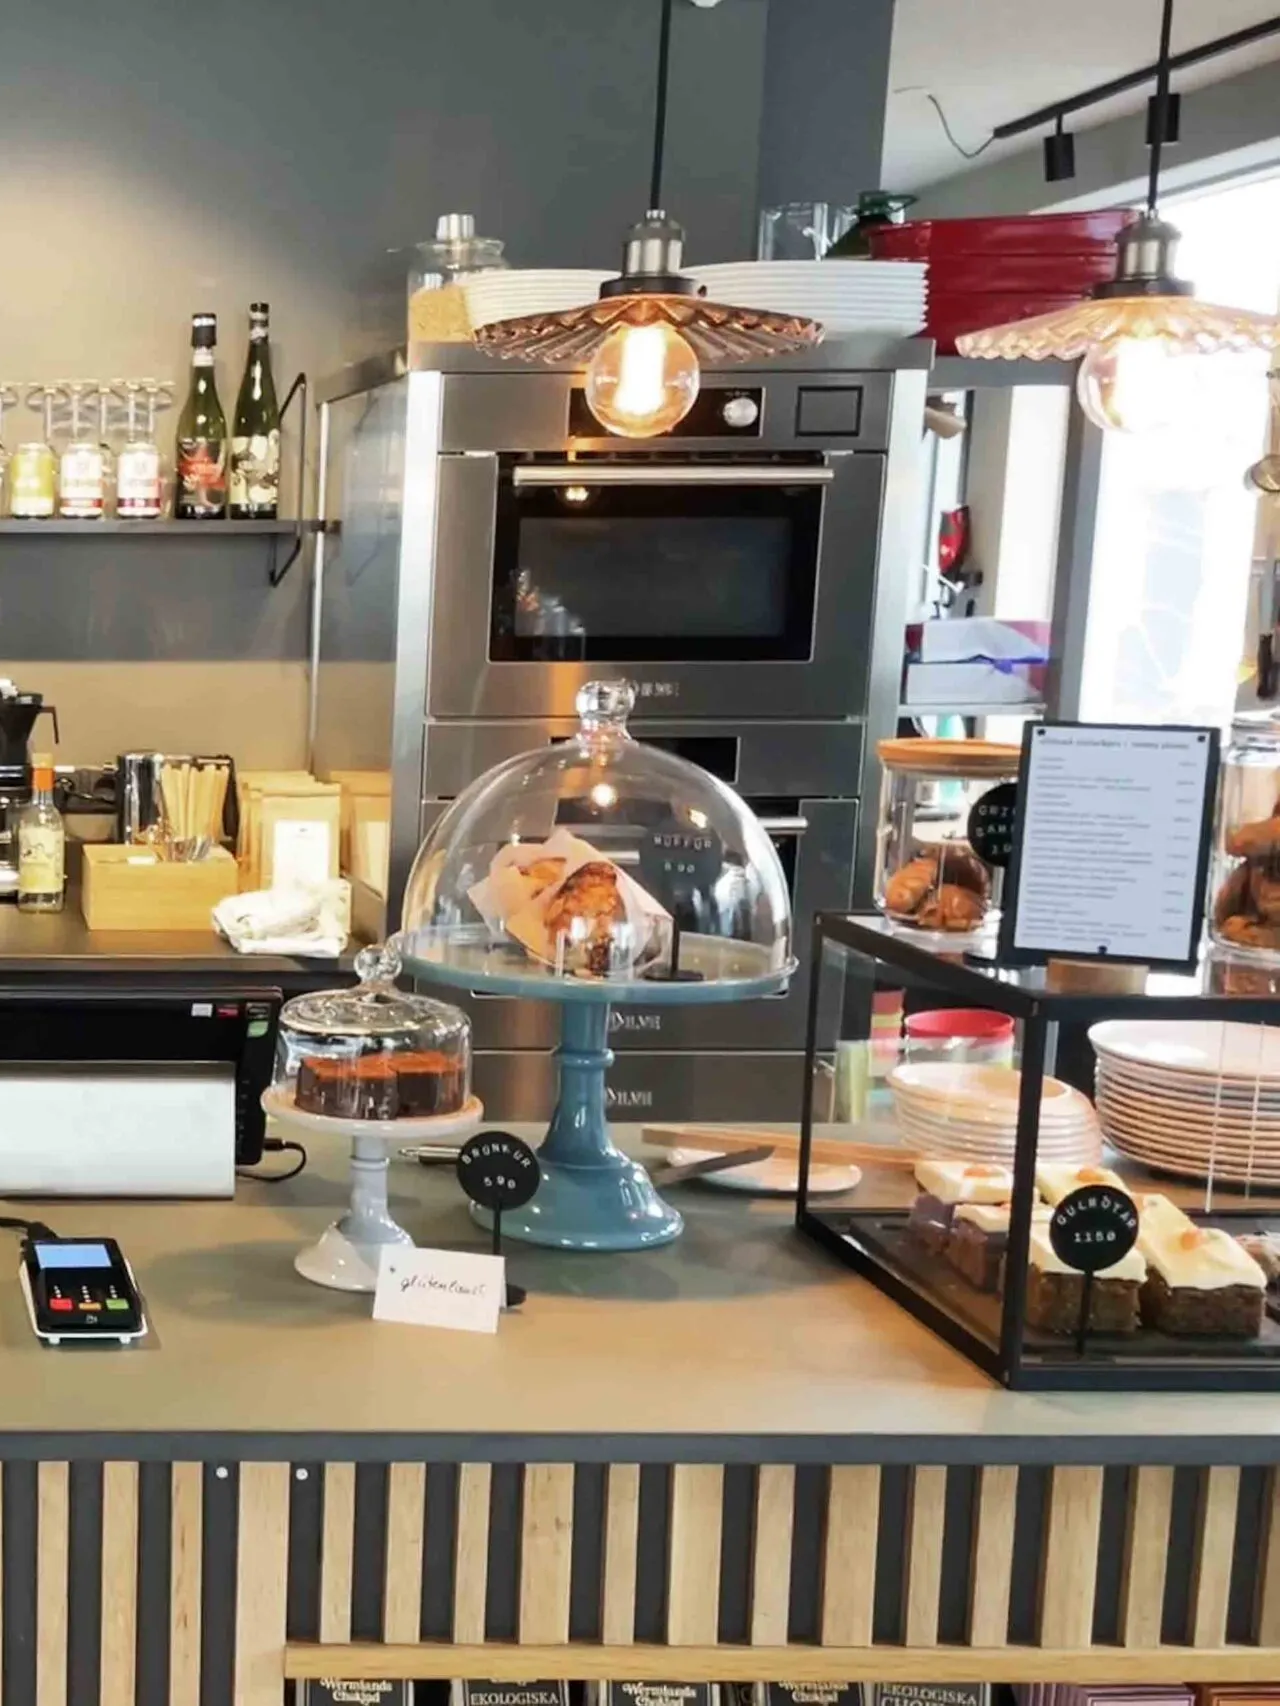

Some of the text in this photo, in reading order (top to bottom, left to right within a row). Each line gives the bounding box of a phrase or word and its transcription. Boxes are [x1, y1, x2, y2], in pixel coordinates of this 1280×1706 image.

[483, 1175, 517, 1190] 590
[1073, 1230, 1117, 1243] 1150
[470, 1692, 559, 1706] EKOLOGISKA
[882, 1683, 977, 1705] EKOLOGISKA
